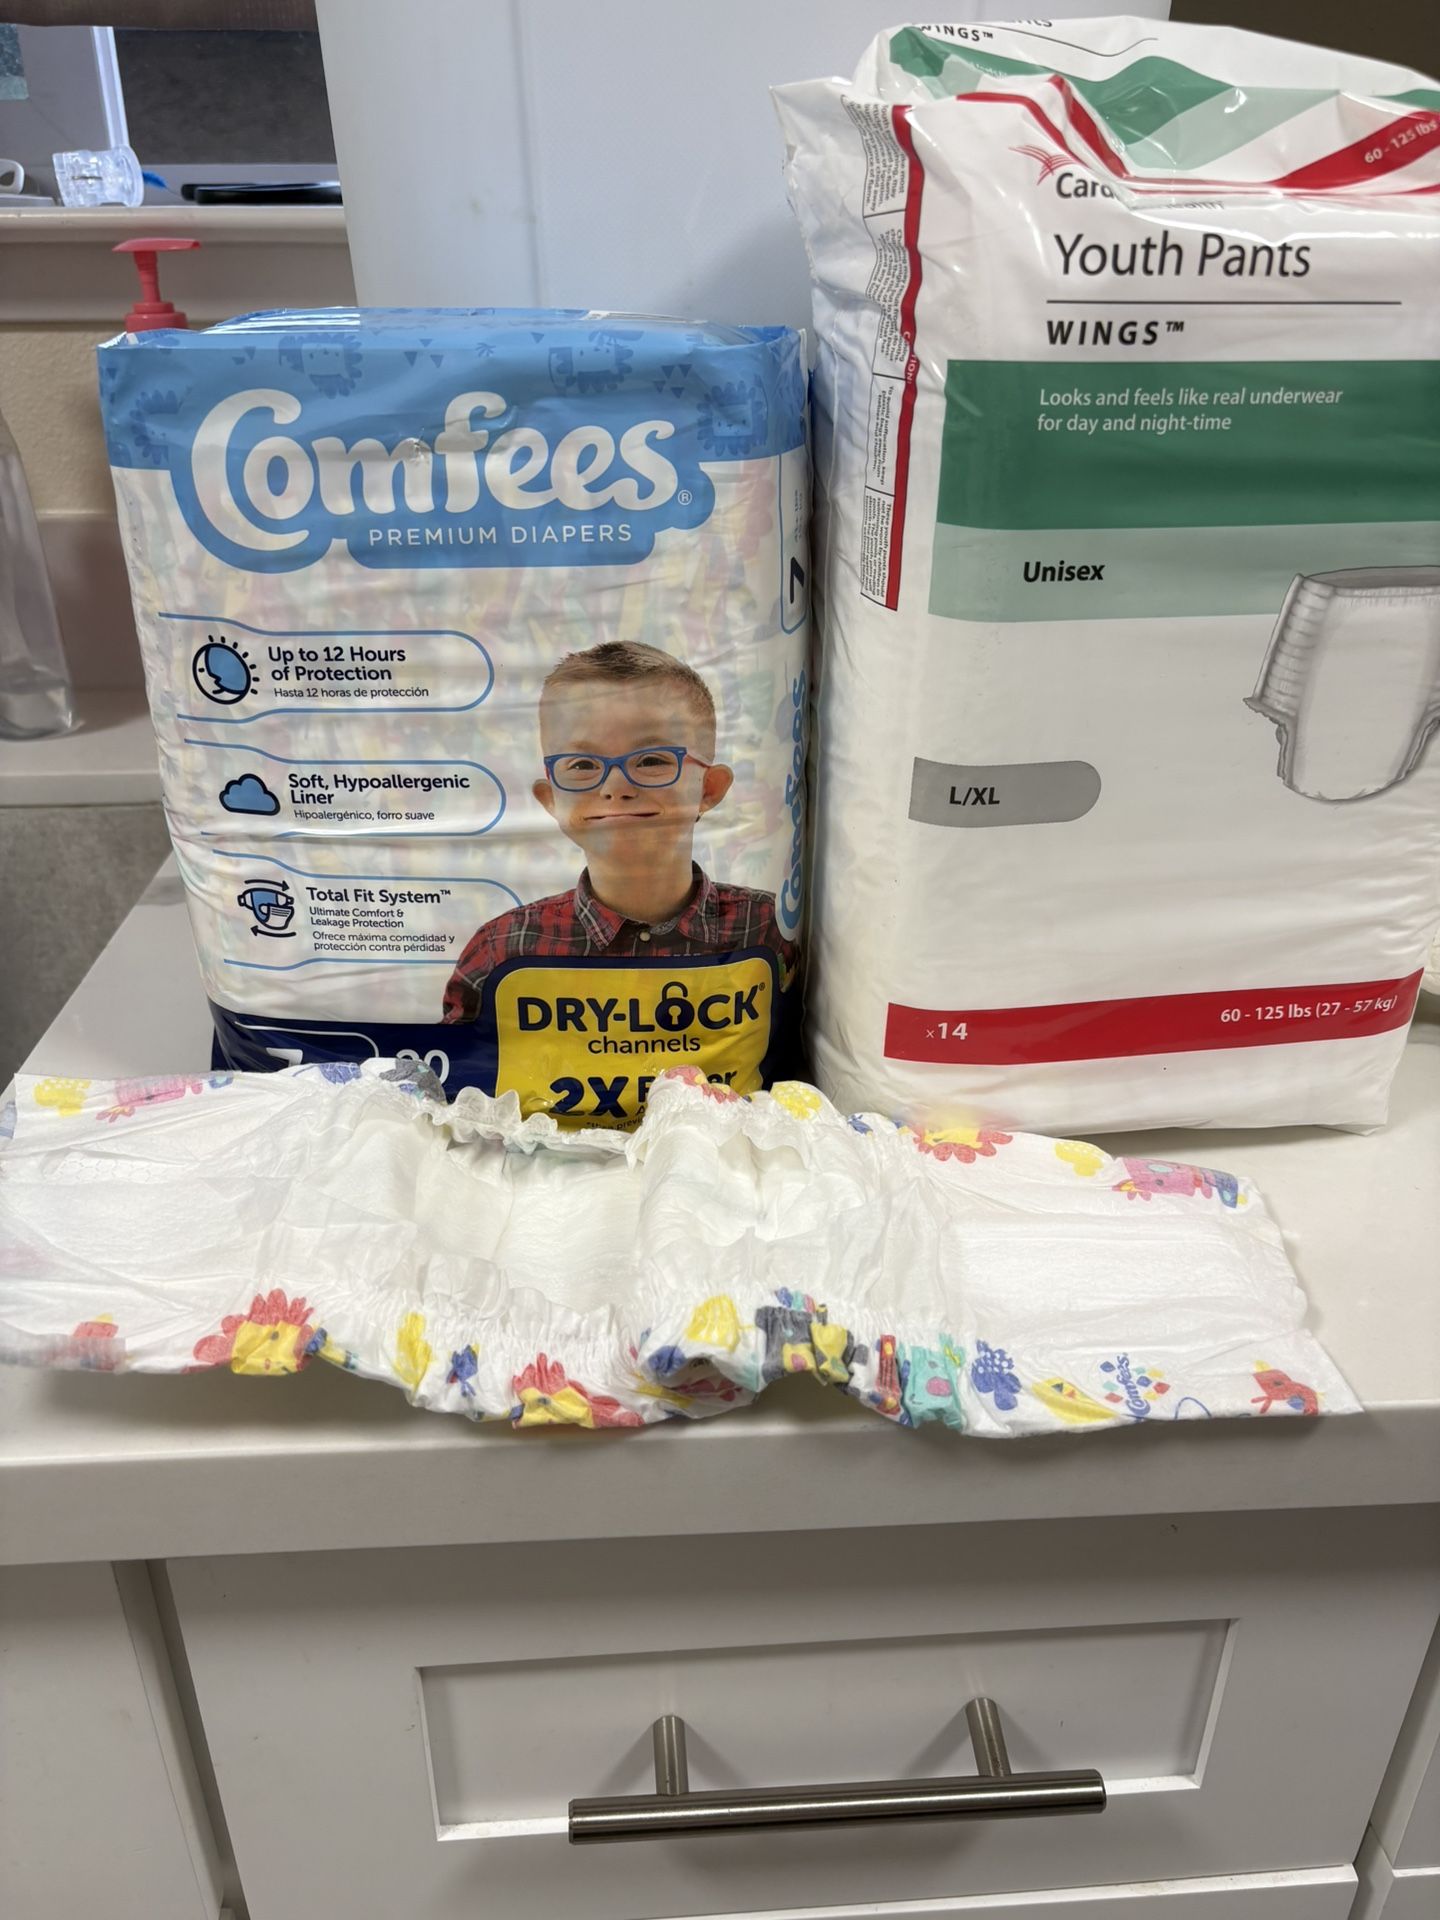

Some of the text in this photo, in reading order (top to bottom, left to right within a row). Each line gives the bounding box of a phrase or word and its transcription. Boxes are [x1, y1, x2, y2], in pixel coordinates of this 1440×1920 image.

[1364, 147, 1383, 164] 60
[1390, 128, 1417, 149] 125
[1414, 119, 1438, 137] lbs
[1053, 230, 1311, 277] Youth Pants
[1039, 387, 1343, 407] Looks and feels like real underwear
[1037, 413, 1232, 436] for day and night-time
[369, 523, 632, 546] PREMIUM DIAPERS
[1023, 560, 1105, 583] Unisex
[268, 646, 406, 665] Up to 12 Hours
[272, 665, 392, 681] of Protection
[274, 686, 429, 700] Hasta 12 horas de protección
[288, 773, 470, 793] Soft, Hypoallergenic
[291, 789, 334, 805] Liner
[949, 786, 1000, 806] L/XL
[294, 809, 435, 822] Hipoalergénico, forro suave
[306, 886, 349, 902] Total
[353, 888, 375, 903] Fit
[310, 907, 404, 918] Ultimate Comfort &
[310, 917, 405, 929] Leakage Protection
[312, 931, 455, 944] Ofrece máxima comodidad y
[314, 941, 446, 953] protección contra pérdidas
[1220, 1008, 1241, 1023] 60
[1255, 1005, 1284, 1020] 125
[1288, 1003, 1312, 1019] lbs
[1315, 1002, 1340, 1019] (27
[1353, 999, 1372, 1013] 57
[1374, 995, 1397, 1012] kg)
[587, 1034, 701, 1055] channels
[550, 1076, 629, 1118] 2X
